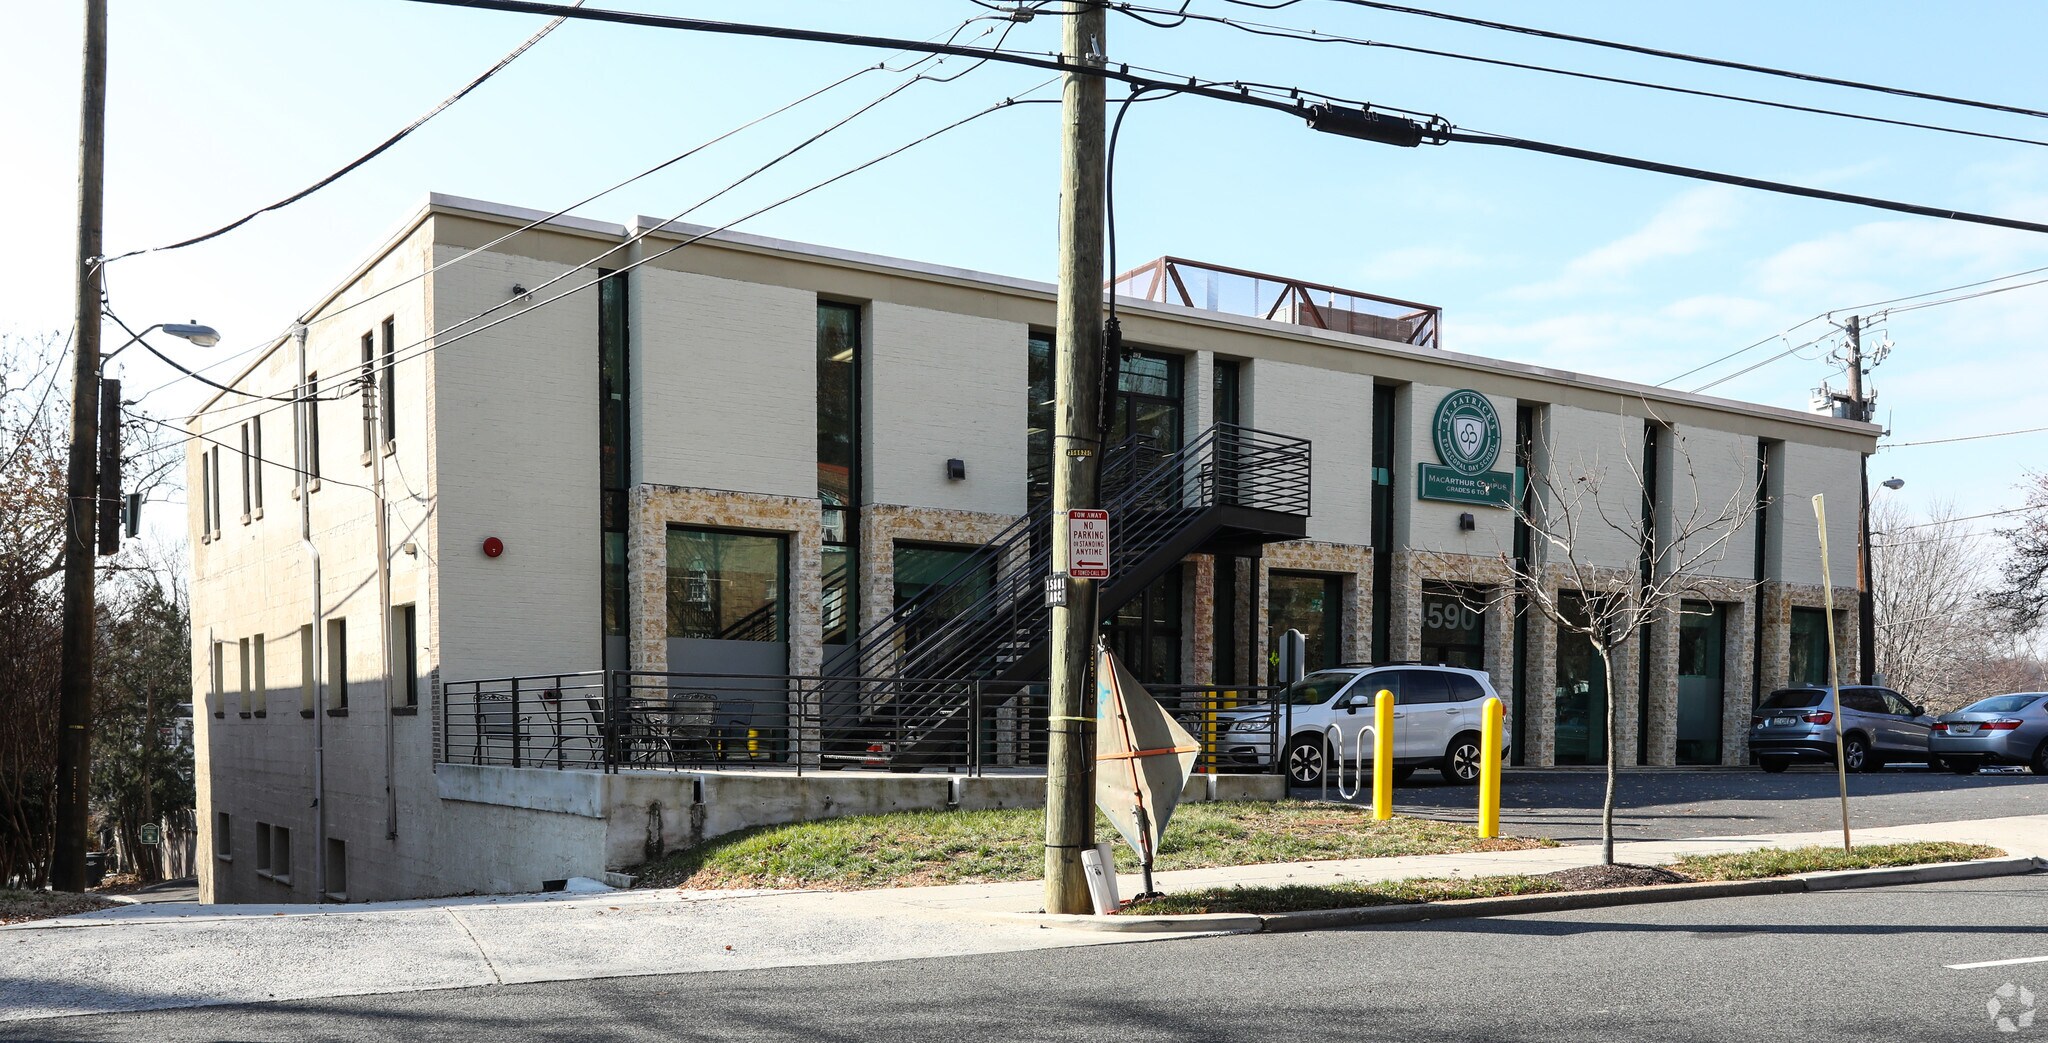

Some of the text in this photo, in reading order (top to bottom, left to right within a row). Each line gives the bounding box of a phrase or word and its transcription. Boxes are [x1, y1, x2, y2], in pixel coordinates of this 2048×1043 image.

[1443, 438, 1467, 471] EPISCOPAL
[1480, 443, 1496, 468] SCHOOL
[1446, 486, 1471, 494] GRADES
[1087, 511, 1102, 519] AWAY
[1083, 521, 1094, 530] NO
[1073, 530, 1104, 540] PARKING
[1075, 548, 1103, 556] ANYTIME
